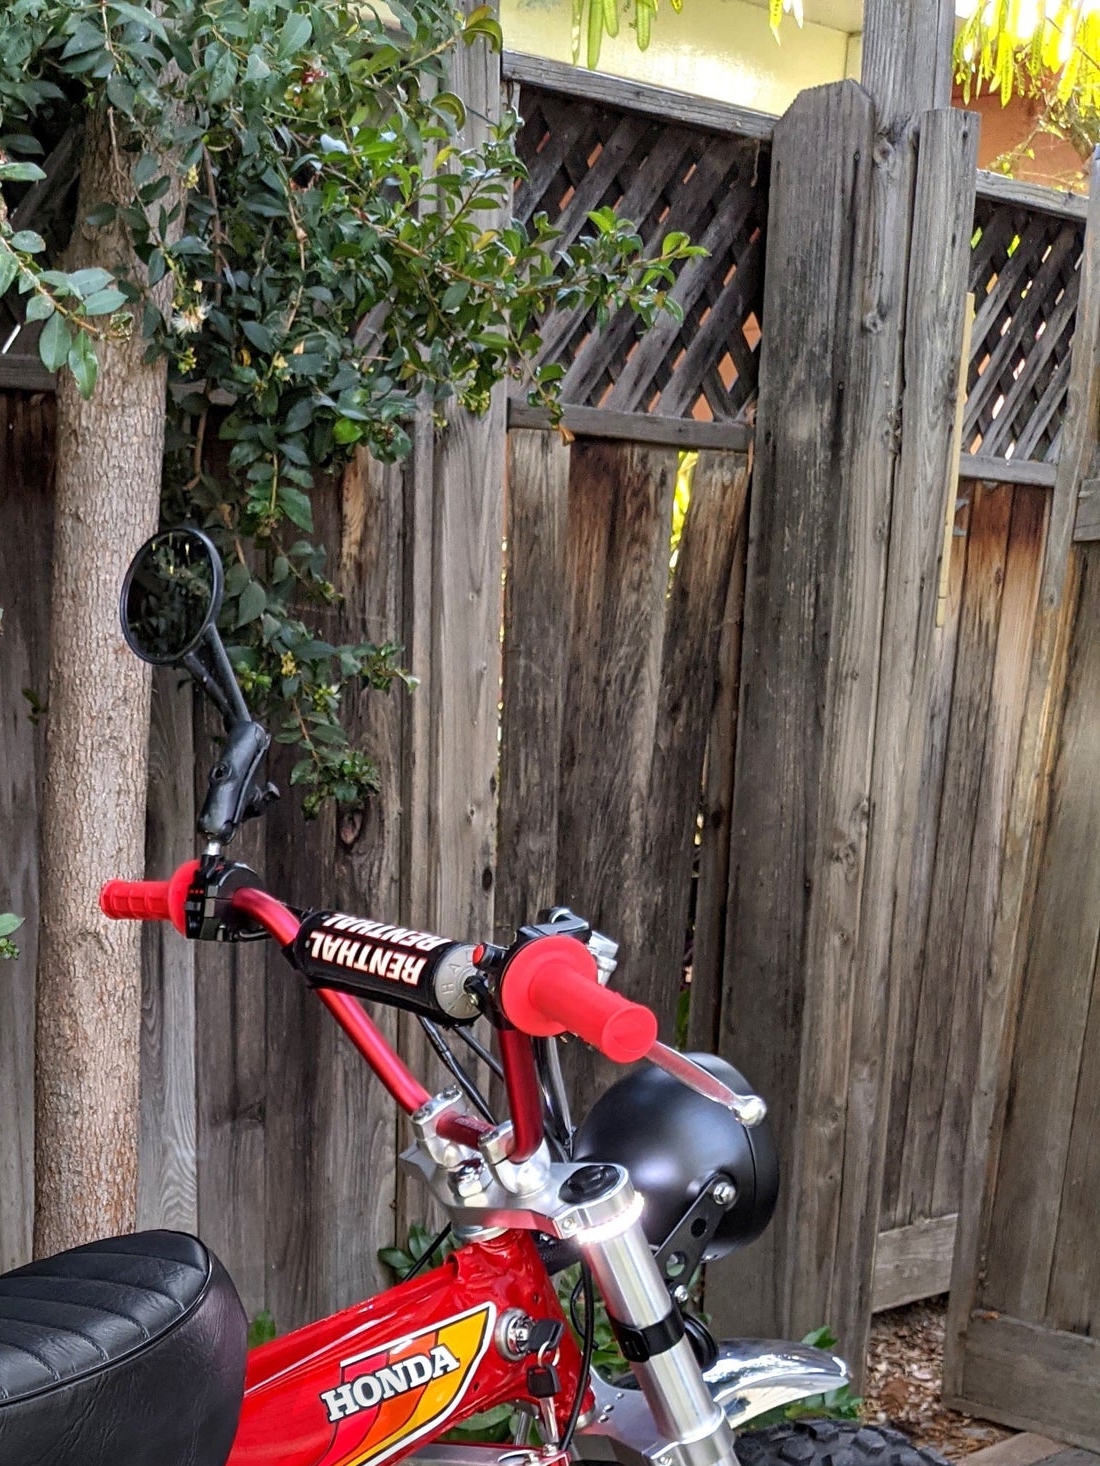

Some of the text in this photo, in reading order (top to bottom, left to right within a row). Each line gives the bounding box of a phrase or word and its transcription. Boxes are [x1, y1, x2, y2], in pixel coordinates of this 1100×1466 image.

[310, 930, 428, 986] RENTHAL
[322, 912, 452, 951] RENTHAL
[320, 1345, 460, 1422] HONDA
